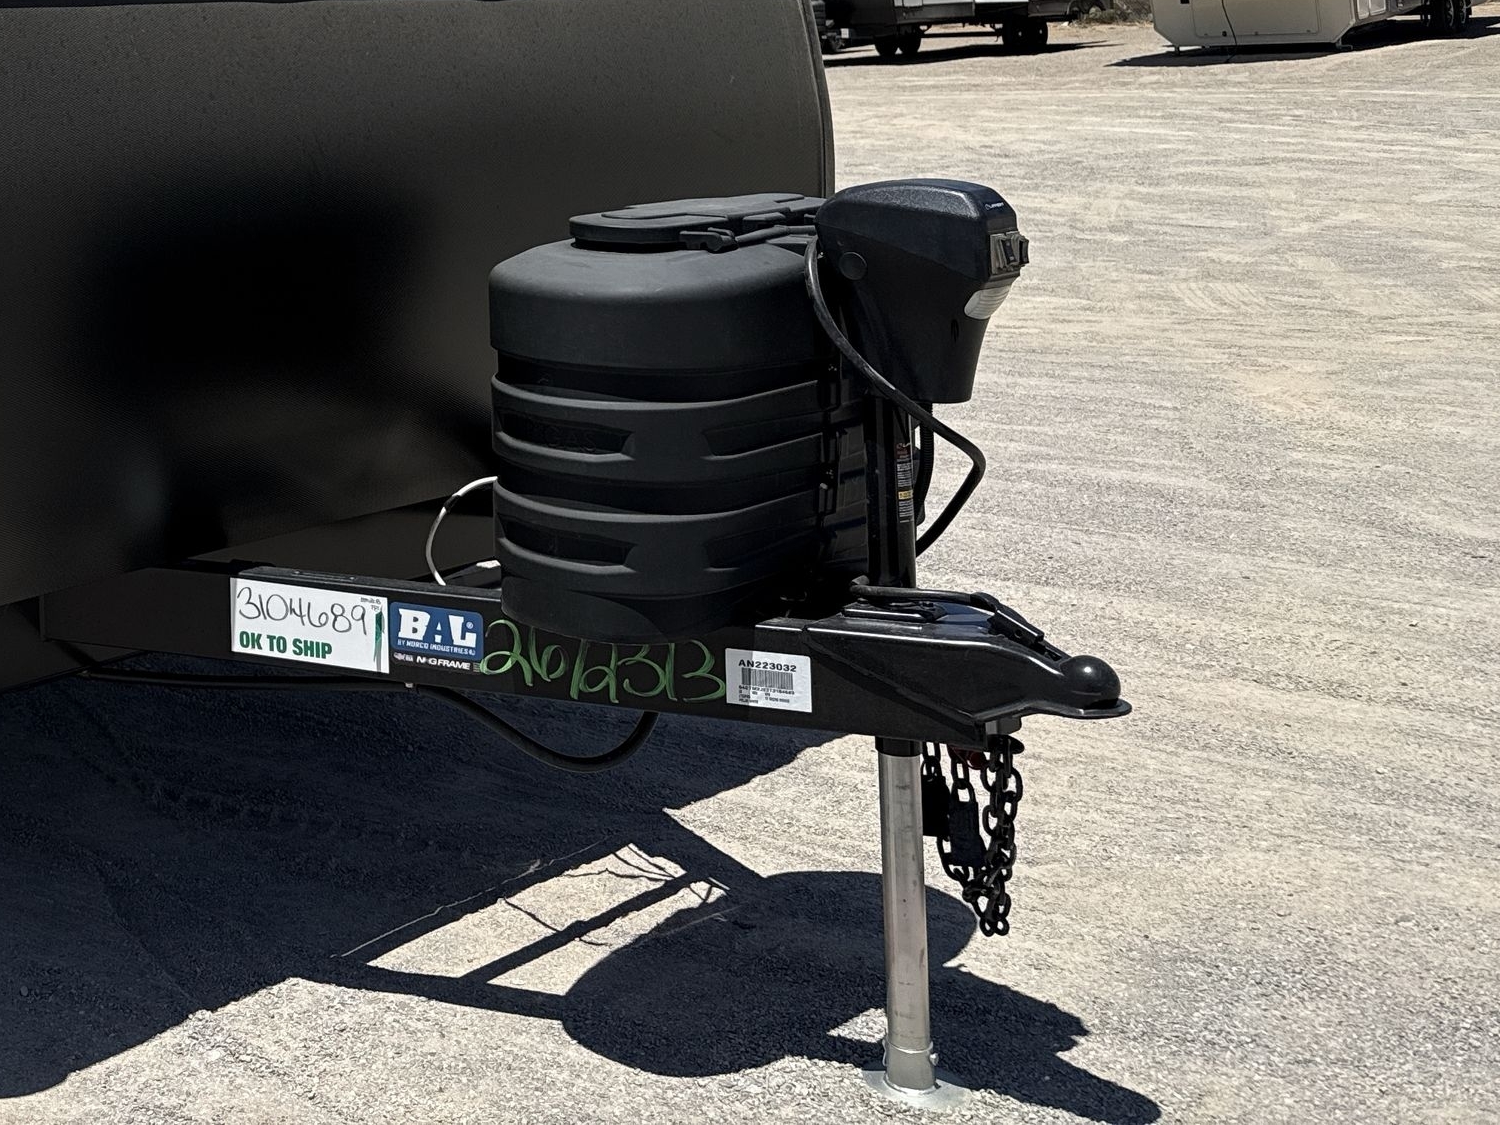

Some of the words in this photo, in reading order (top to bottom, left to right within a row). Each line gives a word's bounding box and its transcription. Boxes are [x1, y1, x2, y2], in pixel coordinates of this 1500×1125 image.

[237, 587, 367, 635] 3104689
[398, 608, 477, 648] BAL
[239, 630, 262, 650] OK
[267, 635, 287, 653] TO
[292, 638, 332, 659] SHIP
[438, 659, 471, 670] FRAME
[738, 659, 797, 673] AN223032
